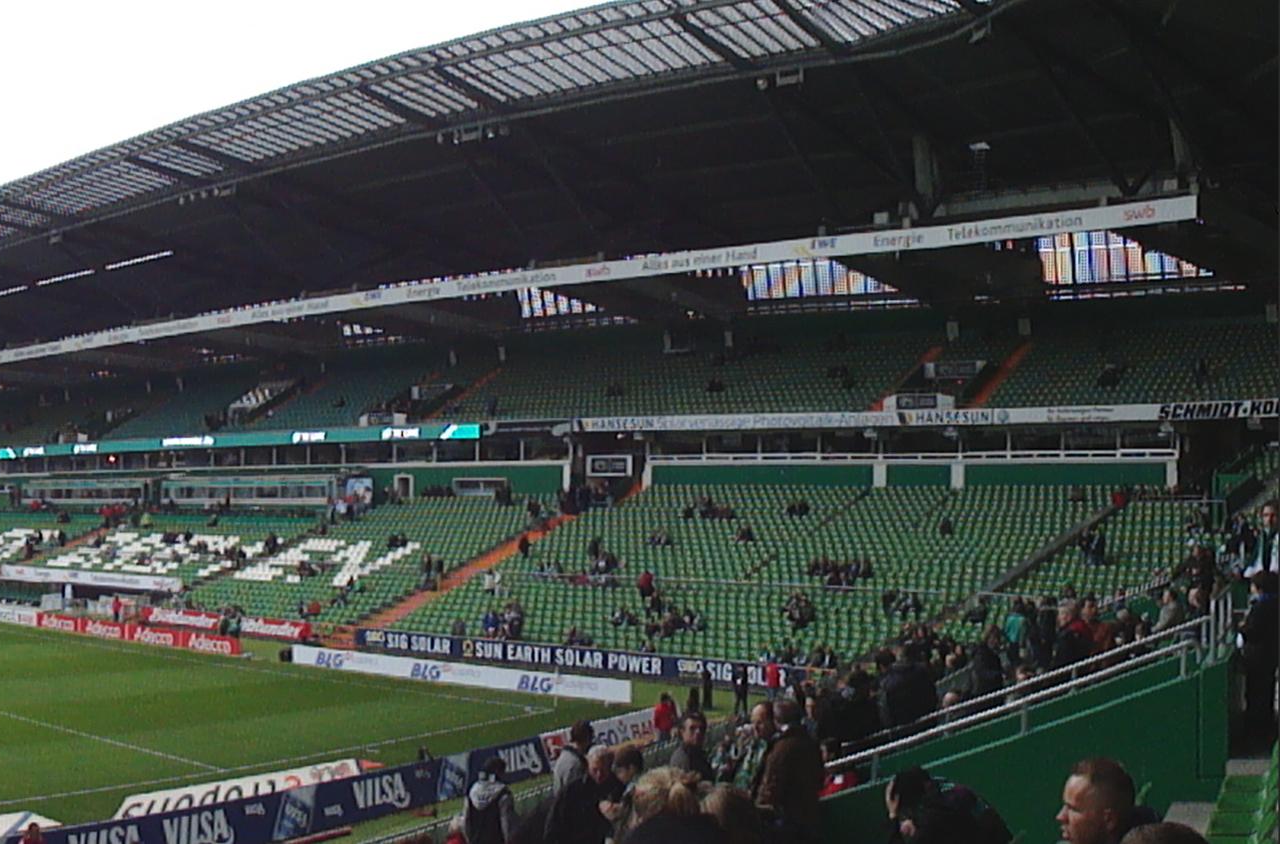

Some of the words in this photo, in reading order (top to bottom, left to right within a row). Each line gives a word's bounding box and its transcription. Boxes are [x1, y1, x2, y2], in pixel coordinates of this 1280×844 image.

[1158, 402, 1241, 419] SCHMIDT
[1250, 400, 1279, 417] KO
[386, 631, 408, 651] SIG
[411, 634, 451, 655] SOLAR
[475, 640, 503, 659] SUN
[507, 643, 551, 664] EARTH
[555, 647, 603, 669] SOLAR
[607, 655, 662, 676] POWER
[353, 772, 410, 808] VILSA
[163, 808, 234, 844] VILSA
